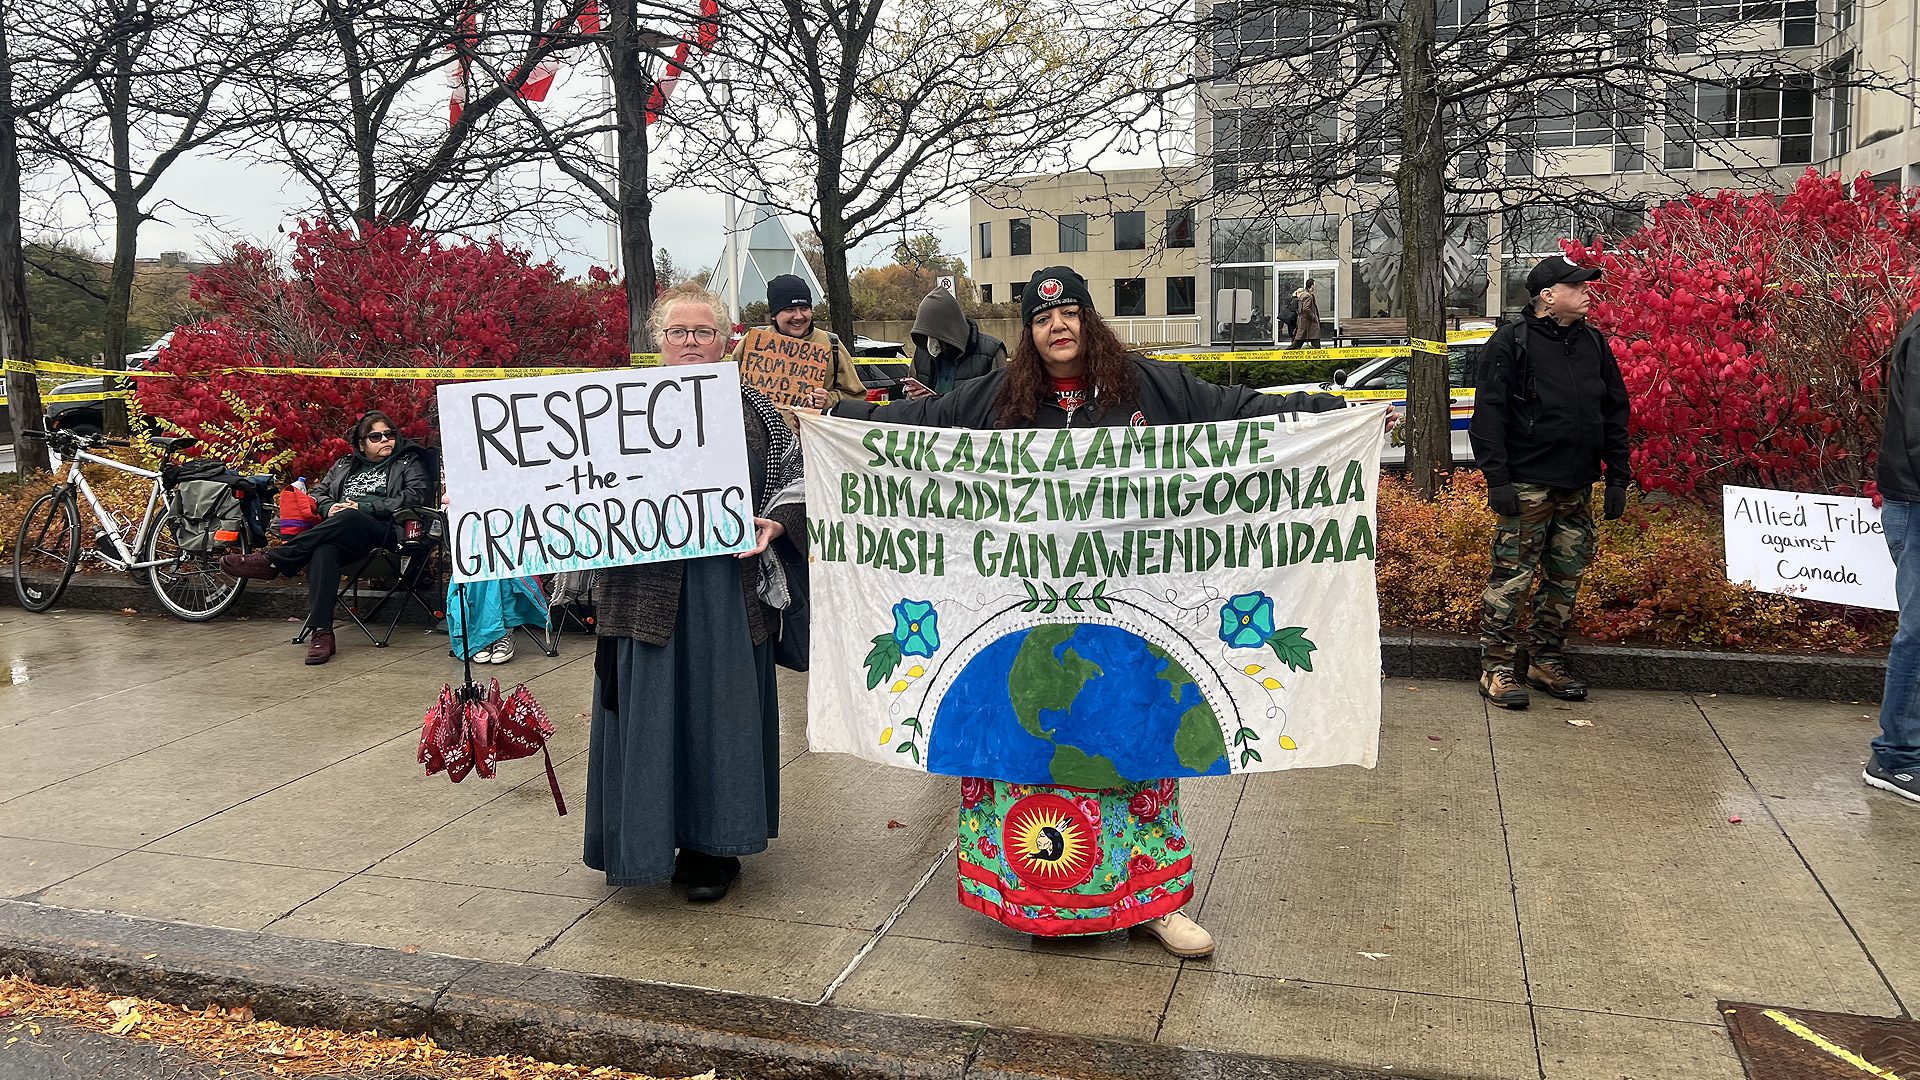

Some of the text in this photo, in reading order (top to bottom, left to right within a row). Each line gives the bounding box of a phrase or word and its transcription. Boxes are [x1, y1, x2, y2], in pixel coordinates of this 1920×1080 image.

[744, 352, 827, 382] FROM TURTLE
[754, 333, 832, 363] LANDBACK
[740, 372, 815, 395] ISLAND TO
[471, 374, 718, 471] RESPECT
[861, 421, 1276, 475] SHKAAKAAMIKWE
[840, 459, 1366, 524] BIIMAADIZIWINIGOONAA
[455, 485, 745, 577] GRASSROOTS
[856, 521, 945, 577] DASH
[972, 514, 1377, 580] GANAWENDIMIDAA
[1761, 533, 1836, 553] against
[1776, 559, 1862, 586] Canada
